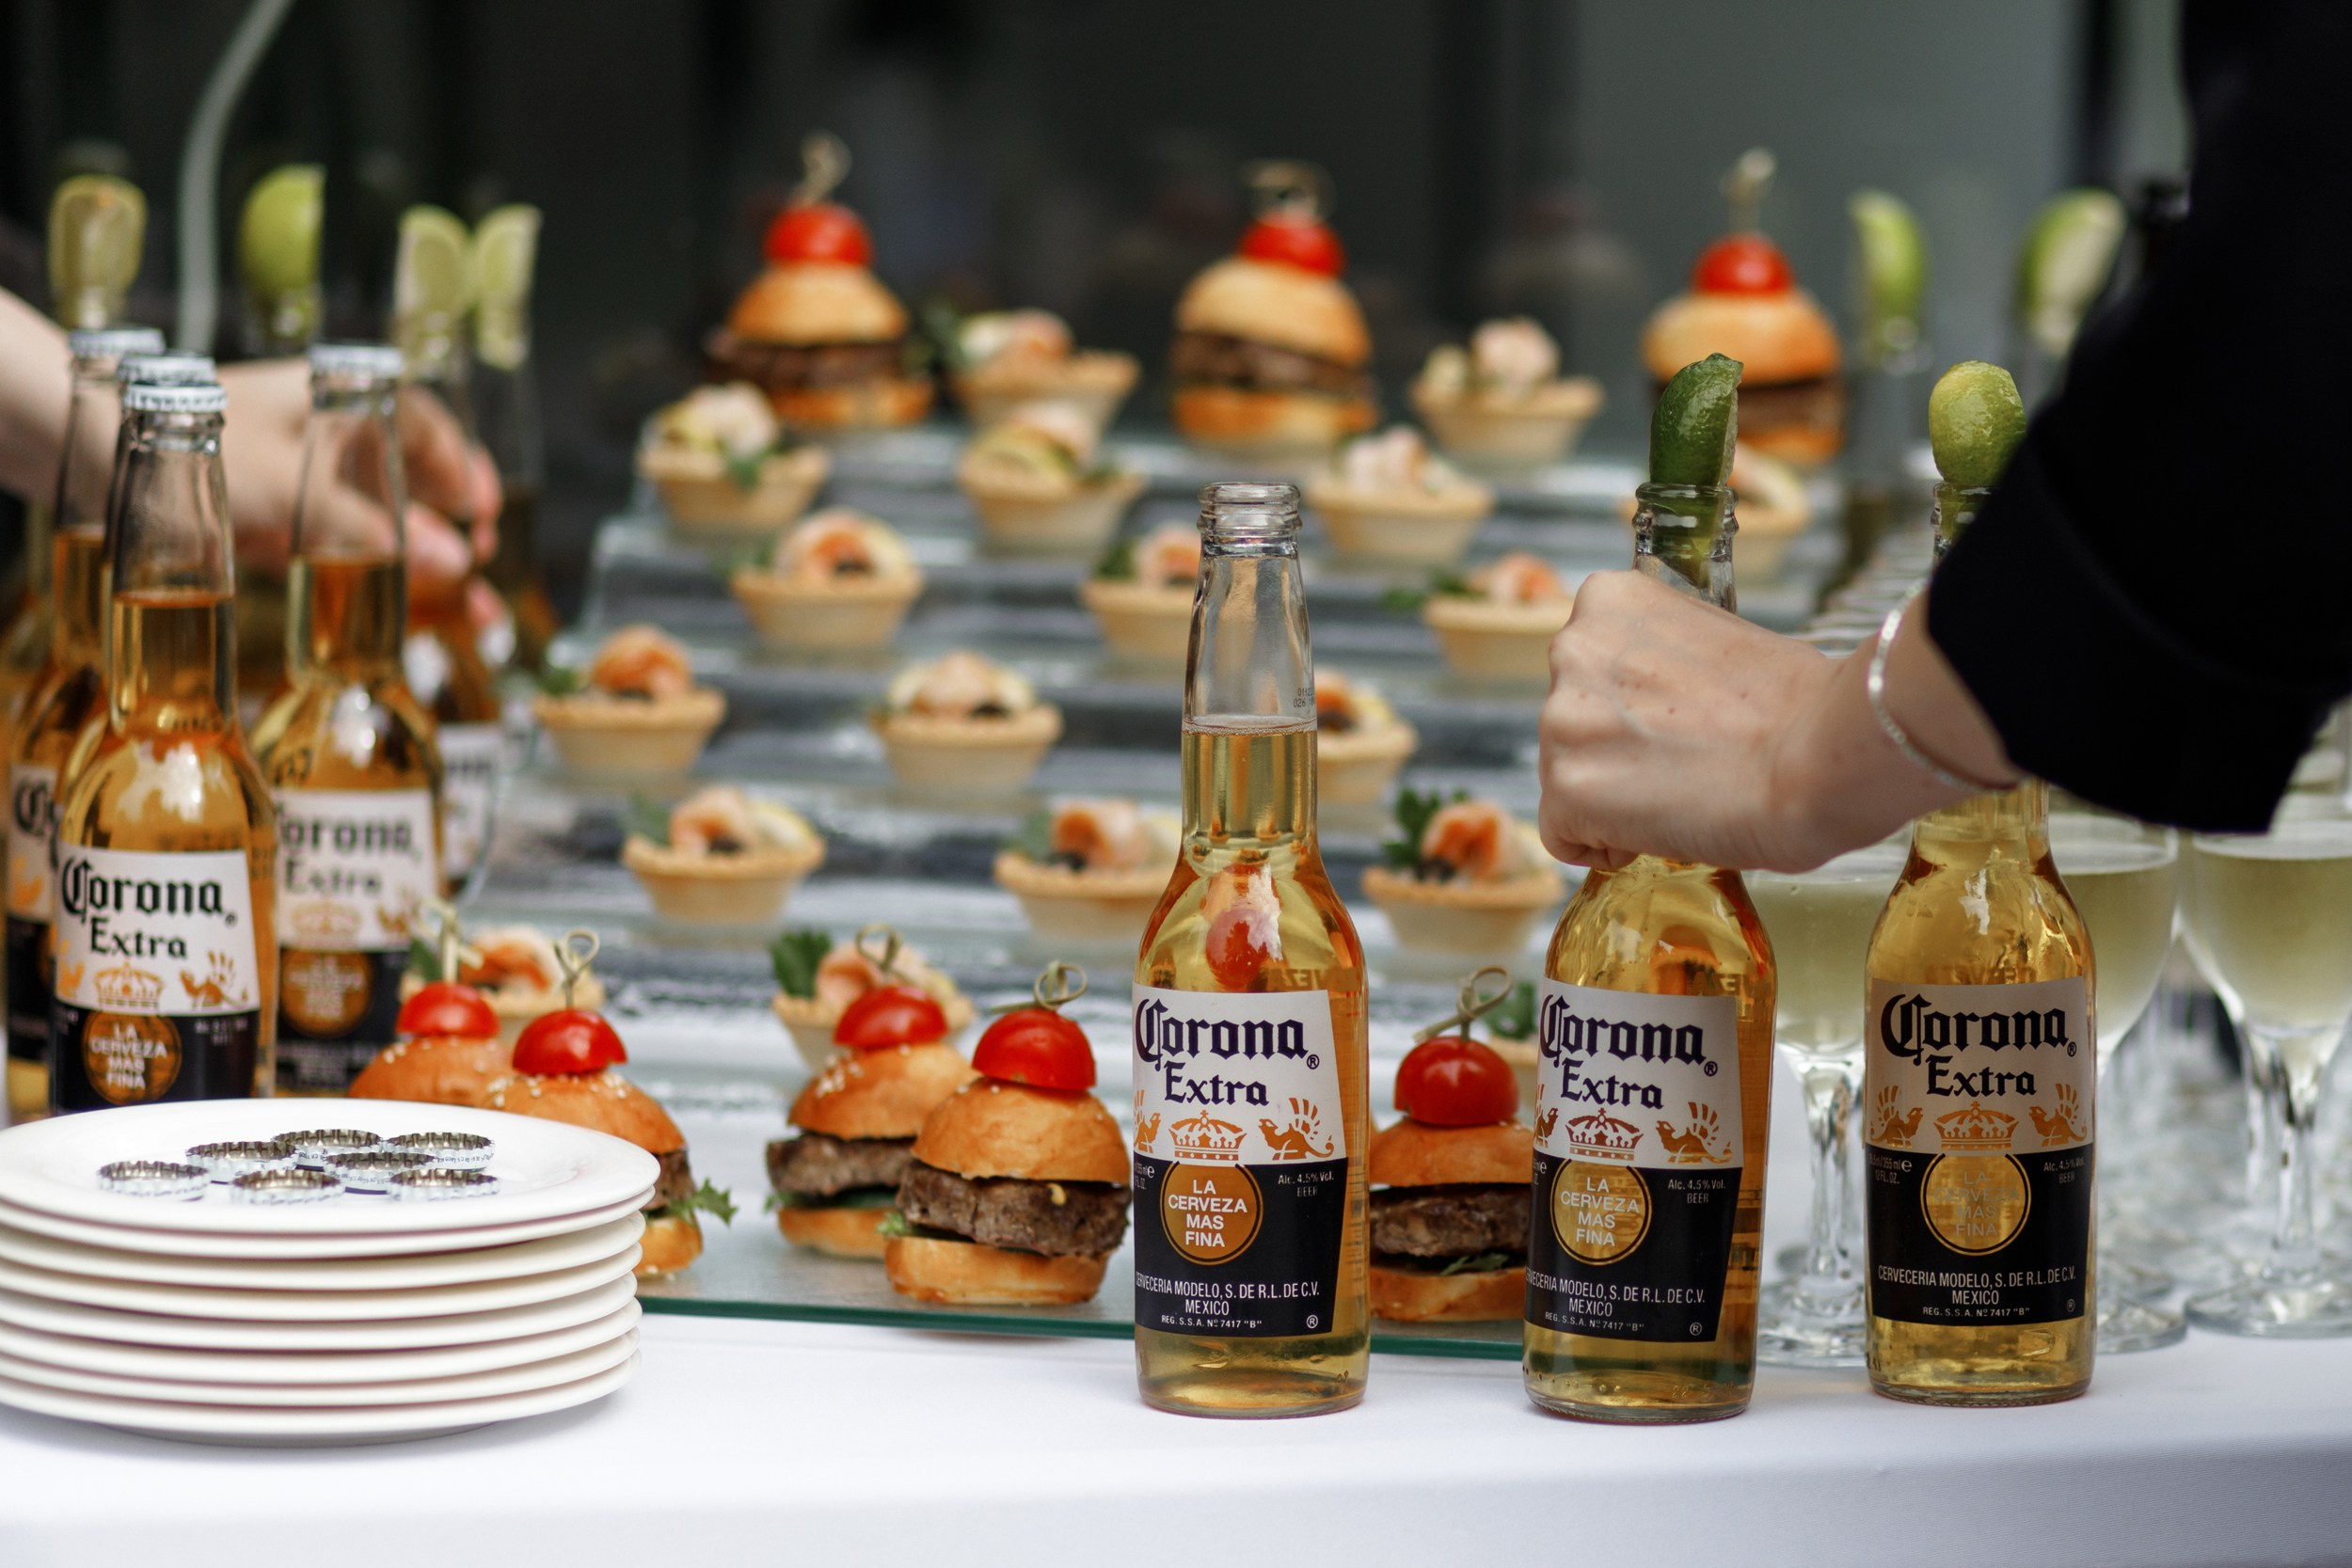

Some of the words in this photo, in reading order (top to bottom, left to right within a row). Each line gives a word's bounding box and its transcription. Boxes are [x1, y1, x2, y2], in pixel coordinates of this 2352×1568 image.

[277, 803, 412, 854] orona
[62, 857, 223, 925] Corona
[90, 915, 187, 958] Extra
[114, 1022, 137, 1039] LA
[1135, 998, 1309, 1071] Corona
[1539, 994, 1707, 1069] Corona
[1881, 993, 2069, 1066] Corona
[89, 1037, 167, 1058] CERVEZA
[107, 1055, 145, 1074] MAS
[105, 1071, 146, 1090] FINA
[1163, 1060, 1270, 1106] Extra
[1561, 1056, 1664, 1110] Extra
[1925, 1053, 2037, 1098] Extra
[2043, 1162, 2058, 1172] Alc.
[1278, 1174, 1295, 1185] Alc.
[1297, 1173, 1318, 1183] 4.5%
[1319, 1170, 1335, 1182] Vol.
[1586, 1176, 1610, 1193] LA
[1667, 1179, 1686, 1190] Alc.
[1687, 1179, 1710, 1190] 4.5%
[1711, 1179, 1725, 1190] Vol.
[1963, 1170, 1988, 1185] LA
[2058, 1171, 2075, 1183] BEER
[1193, 1179, 1216, 1195] LA
[1933, 1188, 2019, 1203] CERVEZA
[1168, 1194, 1248, 1213] CERVEZA
[1560, 1190, 1641, 1213] CERVEZA
[1687, 1192, 1709, 1204] BEER
[1186, 1213, 1225, 1230] MAS
[1578, 1211, 1616, 1228] MAS
[1957, 1205, 1997, 1220] MAS
[1185, 1230, 1226, 1248] FINA
[1576, 1228, 1616, 1247] FINA
[1956, 1223, 1999, 1237] FINA
[1526, 1266, 1558, 1291] RVECERIA
[1559, 1278, 1607, 1302] MODELO,
[1609, 1285, 1621, 1301] S.
[1623, 1286, 1639, 1302] DE
[1642, 1288, 1665, 1303] R.L.
[1667, 1289, 1683, 1304] DE
[1686, 1289, 1705, 1304] C.V.
[1878, 1264, 1937, 1287] CERVECERIA
[1939, 1273, 1993, 1290] MODELO,
[1994, 1273, 2007, 1288] S.
[2009, 1272, 2024, 1287] DE
[2026, 1270, 2047, 1286] R.L.
[2047, 1268, 2060, 1284] DE
[2061, 1265, 2076, 1281] C.V.
[1174, 1280, 1223, 1301] MODELO,
[1225, 1283, 1237, 1299] S.
[1239, 1284, 1255, 1299] DE
[1258, 1284, 1281, 1299] R.L.
[1283, 1283, 1298, 1298] DE
[1301, 1281, 1319, 1297] C.V.
[1951, 1290, 1999, 1306] MEXICO
[1185, 1299, 1230, 1316] MEXICO
[1568, 1297, 1613, 1317] MEXICO
[1922, 1307, 1943, 1316] REG.
[1990, 1308, 2011, 1317] 7417
[2013, 1307, 2030, 1316] "B"
[1161, 1314, 1178, 1324] REG.
[1220, 1320, 1241, 1328] 7417
[1244, 1320, 1263, 1328] "B"
[1545, 1311, 1561, 1323] REG.
[1602, 1321, 1624, 1331] 7417
